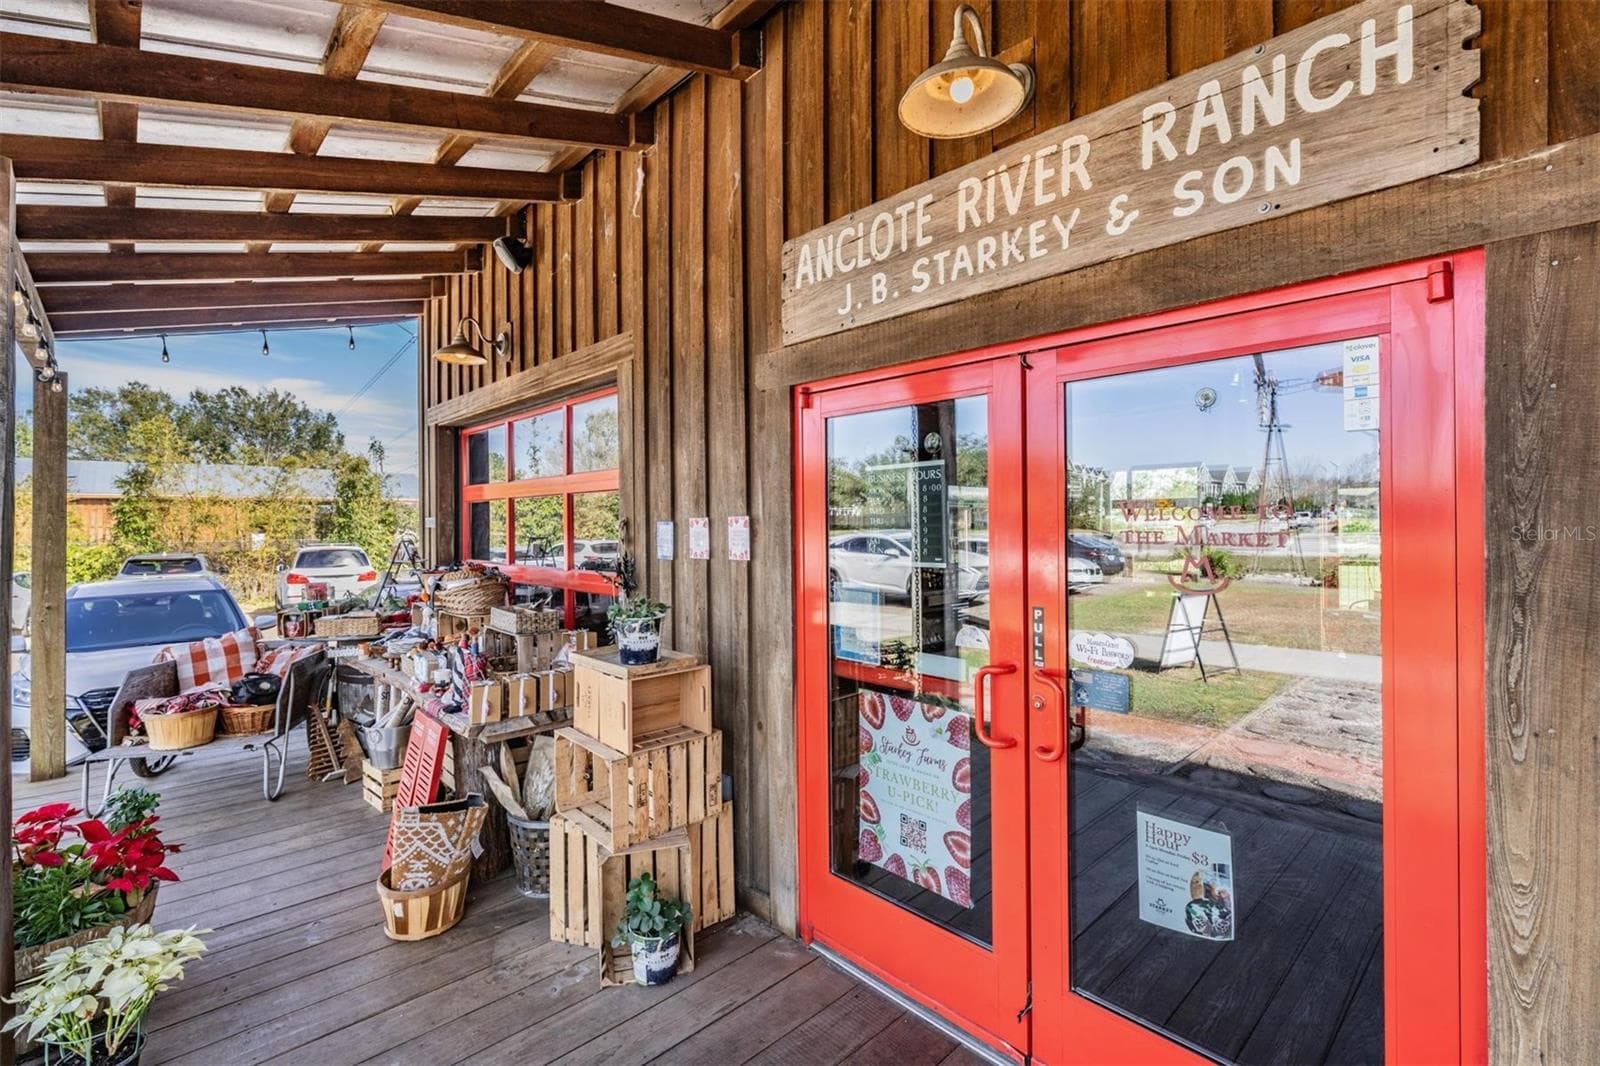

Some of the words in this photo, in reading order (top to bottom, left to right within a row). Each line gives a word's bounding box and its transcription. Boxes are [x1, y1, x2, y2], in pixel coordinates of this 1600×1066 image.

[796, 194, 933, 289] ANCLOTE
[957, 134, 1092, 233] RIVER
[1141, 4, 1414, 170] RANCH
[838, 283, 862, 315] J.
[872, 272, 899, 304] B.
[911, 208, 1081, 293] STARKEY
[1106, 194, 1139, 236] &
[1173, 138, 1302, 217] SON
[1351, 354, 1370, 362] VISA
[1034, 609, 1043, 660] PULL
[867, 764, 958, 803] STRAWBERRY
[888, 786, 938, 813] U-PICK!
[1145, 821, 1191, 846] Happy
[1145, 831, 1182, 851] Hour
[1191, 851, 1209, 866] $3
